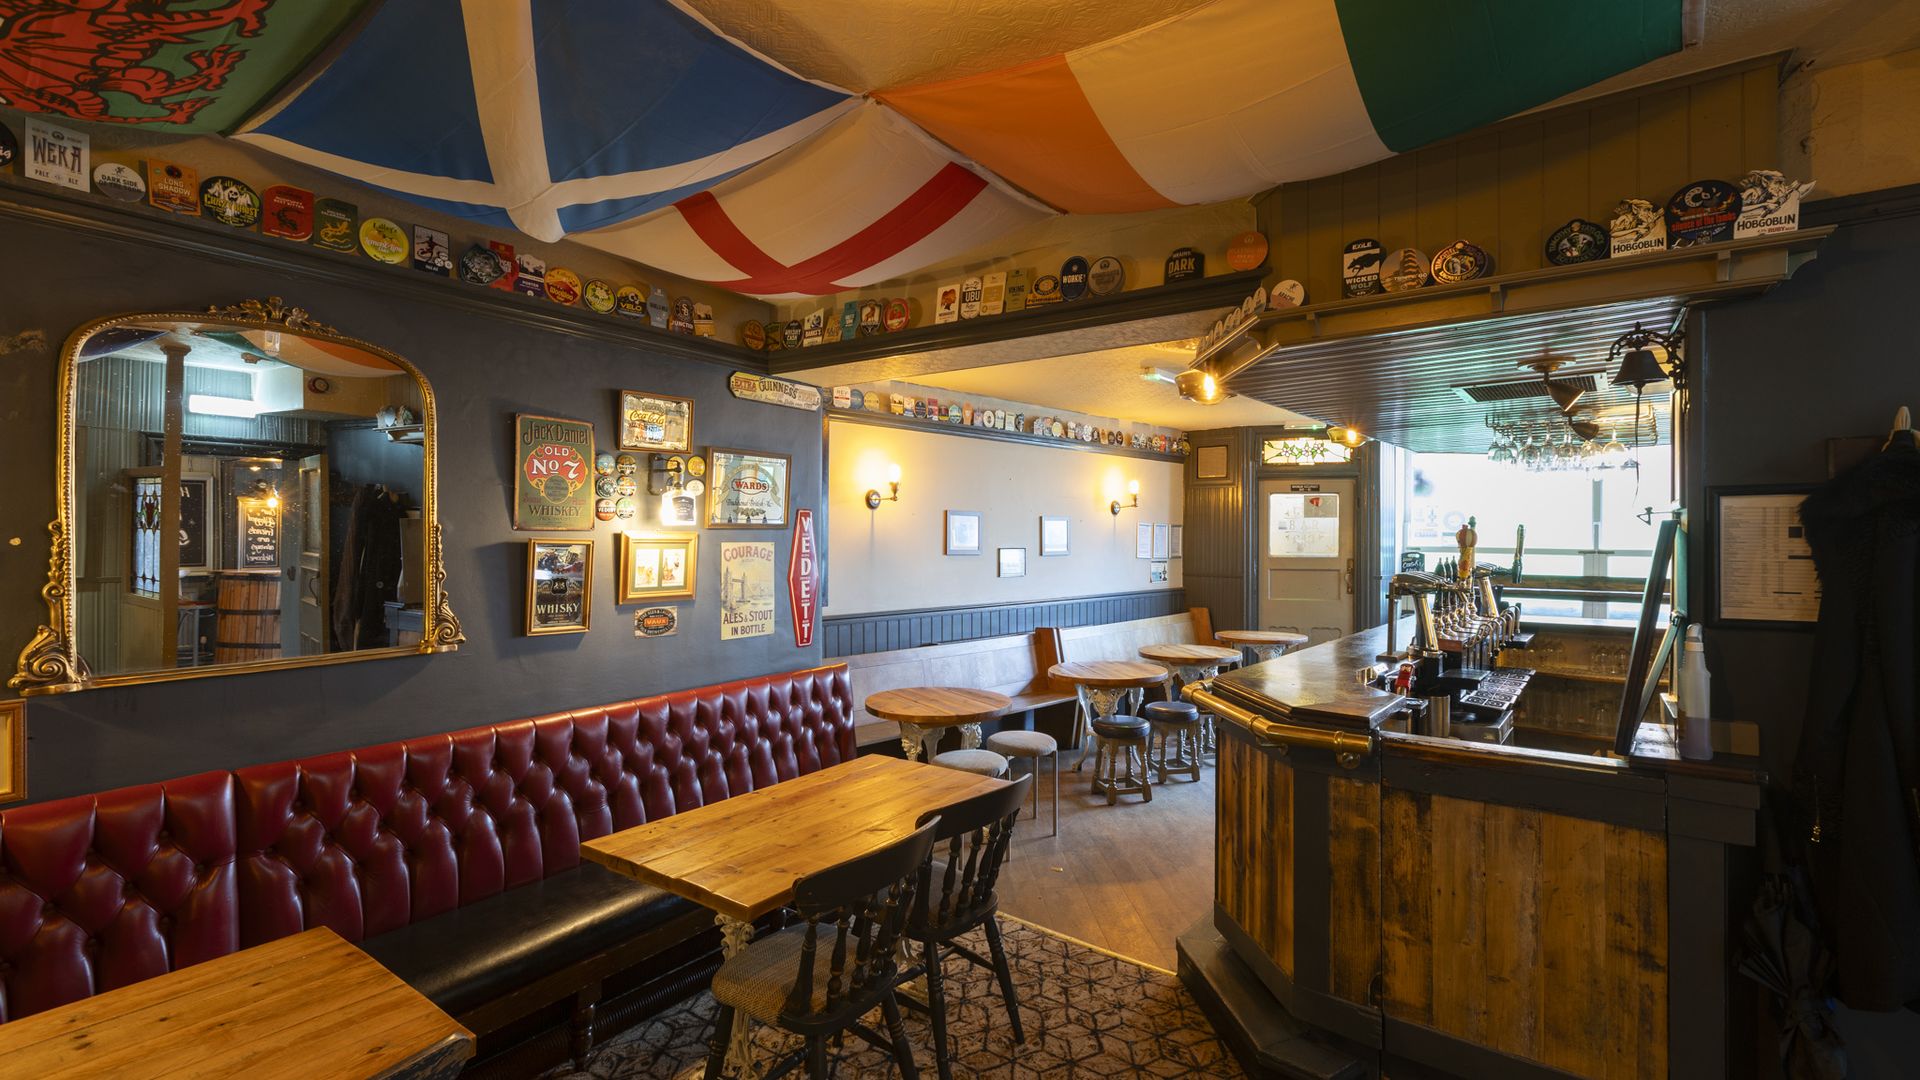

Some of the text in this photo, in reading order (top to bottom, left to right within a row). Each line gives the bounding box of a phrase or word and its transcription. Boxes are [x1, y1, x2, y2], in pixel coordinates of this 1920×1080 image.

[32, 135, 82, 174] WEKA
[34, 169, 79, 186] PALE ALE
[101, 174, 138, 188] DARK SIDE
[164, 177, 184, 188] LONG
[158, 183, 191, 197] SHADOW
[1737, 214, 1796, 231] HOBGOBLIN
[1612, 237, 1665, 254] HOBGOBLIN
[1167, 257, 1196, 274] DARK
[1345, 274, 1379, 286] WICKED
[1350, 282, 1373, 291] WOLF
[965, 290, 981, 303] UBU
[620, 302, 642, 312] VELO
[758, 376, 799, 400] GUINNESS
[523, 421, 590, 446] Jack Daniel
[544, 446, 570, 456] OLD
[563, 460, 581, 480] 7
[735, 481, 768, 491] WARDS
[529, 504, 582, 517] WHISKEY
[723, 545, 773, 563] COURAGE
[801, 516, 812, 639] VEDETT
[536, 602, 580, 615] WHISKY
[723, 612, 744, 625] ALES
[748, 609, 773, 623] STOUT
[731, 623, 766, 636] IN BOTTLE
